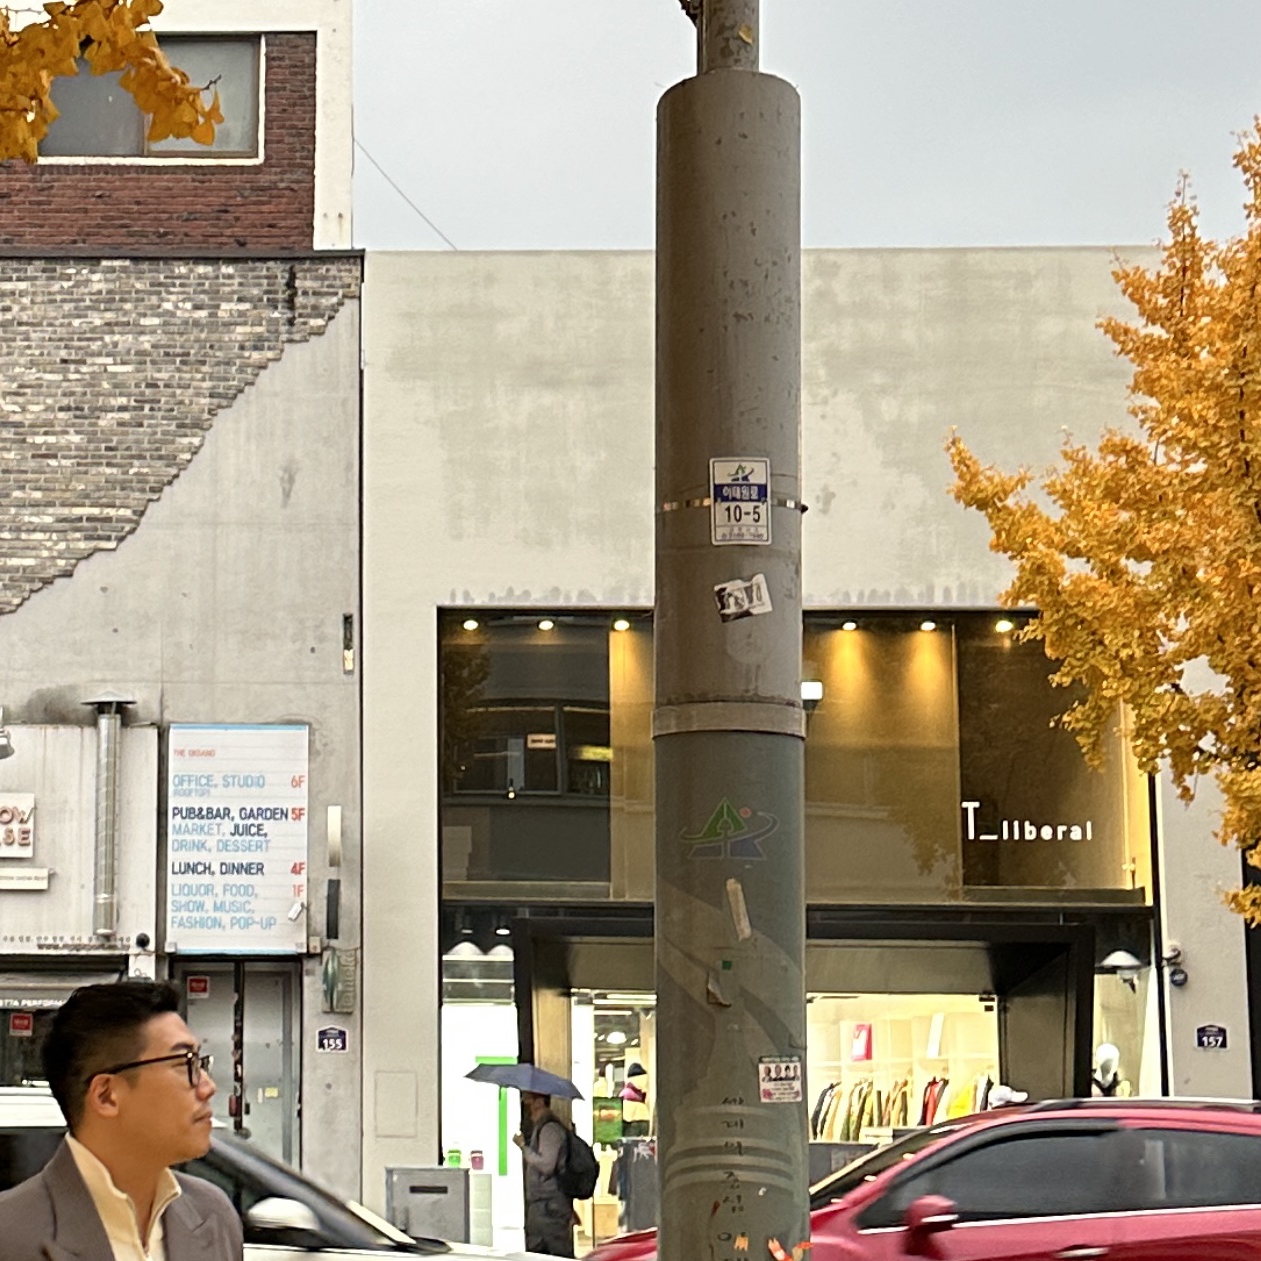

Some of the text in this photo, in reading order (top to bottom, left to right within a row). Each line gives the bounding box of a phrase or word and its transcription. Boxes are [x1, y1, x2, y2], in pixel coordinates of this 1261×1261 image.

[724, 504, 761, 523] 10-5
[172, 774, 306, 789] OFFICE, STUDIO 6F
[172, 806, 306, 822] PUB&BAR, GARDEN 5F
[171, 822, 268, 838] MARKET, JUICE,
[216, 839, 271, 853] DESSERT
[171, 861, 306, 876] LUNCH, DINNER 4F
[222, 883, 259, 898] FOOD,
[292, 884, 305, 898] 1F
[171, 916, 277, 931] FASHION, POP-UP
[322, 1038, 343, 1050] 155
[1202, 1036, 1223, 1048] 157
